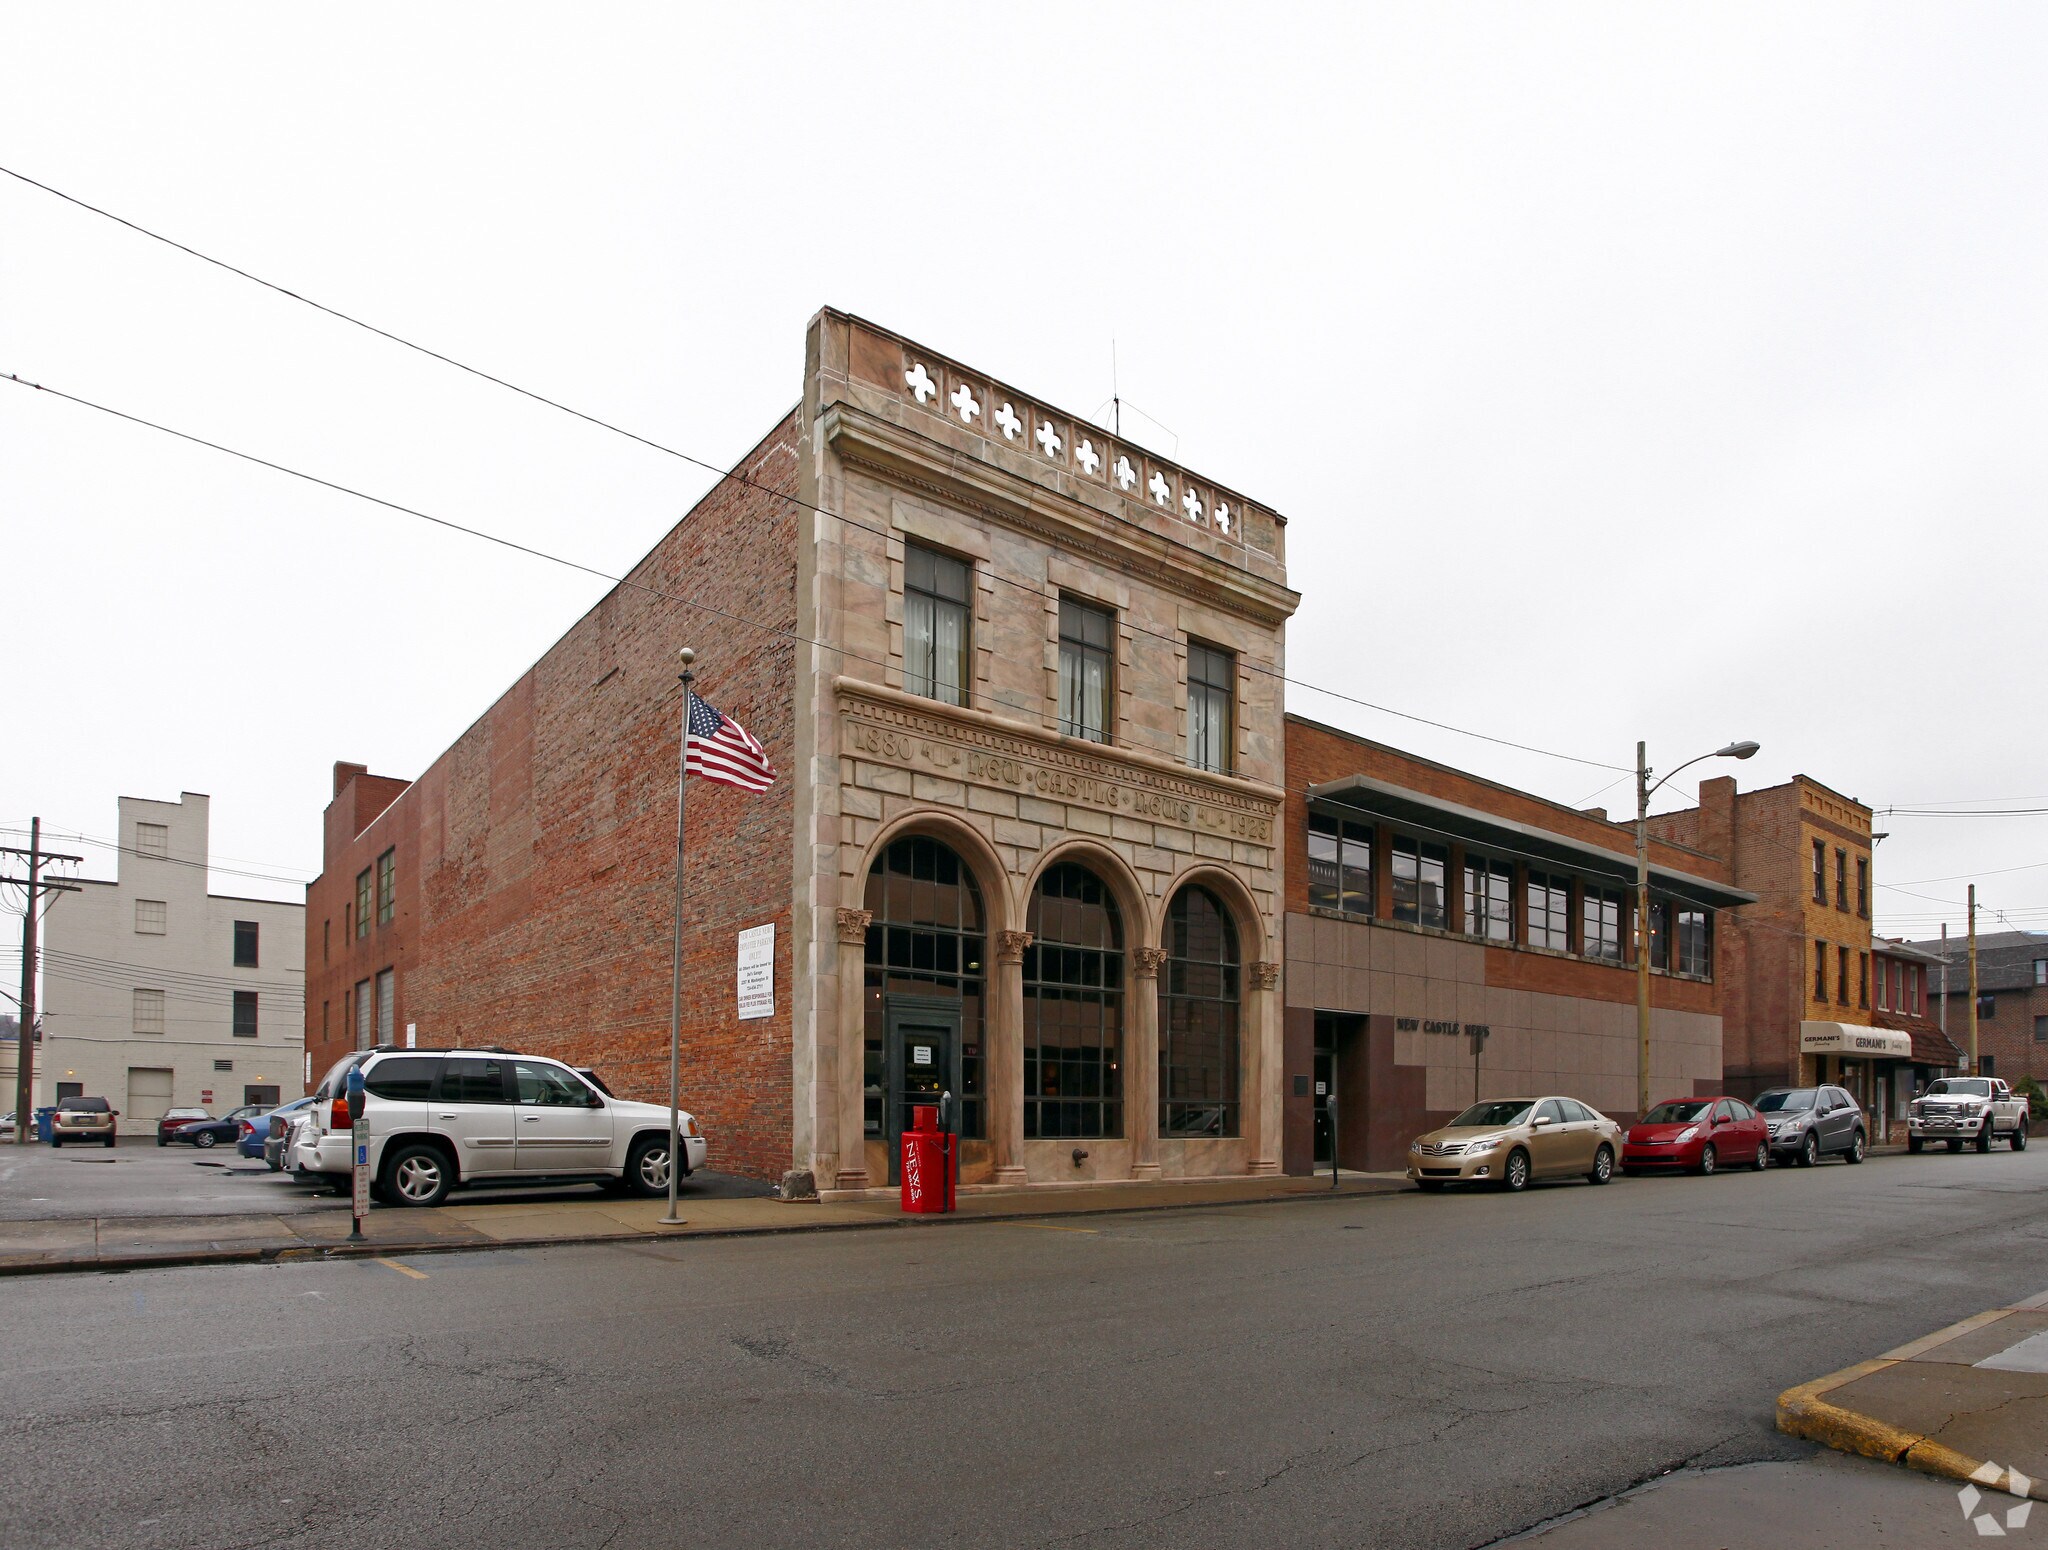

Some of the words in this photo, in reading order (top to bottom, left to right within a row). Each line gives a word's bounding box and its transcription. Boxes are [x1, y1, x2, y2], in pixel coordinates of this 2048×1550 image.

[855, 725, 914, 761] 1880
[967, 752, 1023, 785] NEW
[1035, 769, 1119, 807] CASTLE
[1134, 791, 1191, 823] NEWS
[1230, 814, 1269, 840] 1923
[1397, 1018, 1420, 1032] NEW
[1423, 1020, 1460, 1036] CASTLE
[1464, 1023, 1490, 1037] NEWS
[1804, 1035, 1840, 1043] GERMANI'S
[1855, 1038, 1886, 1049] GERMANI'S
[906, 1140, 922, 1199] NEWS
